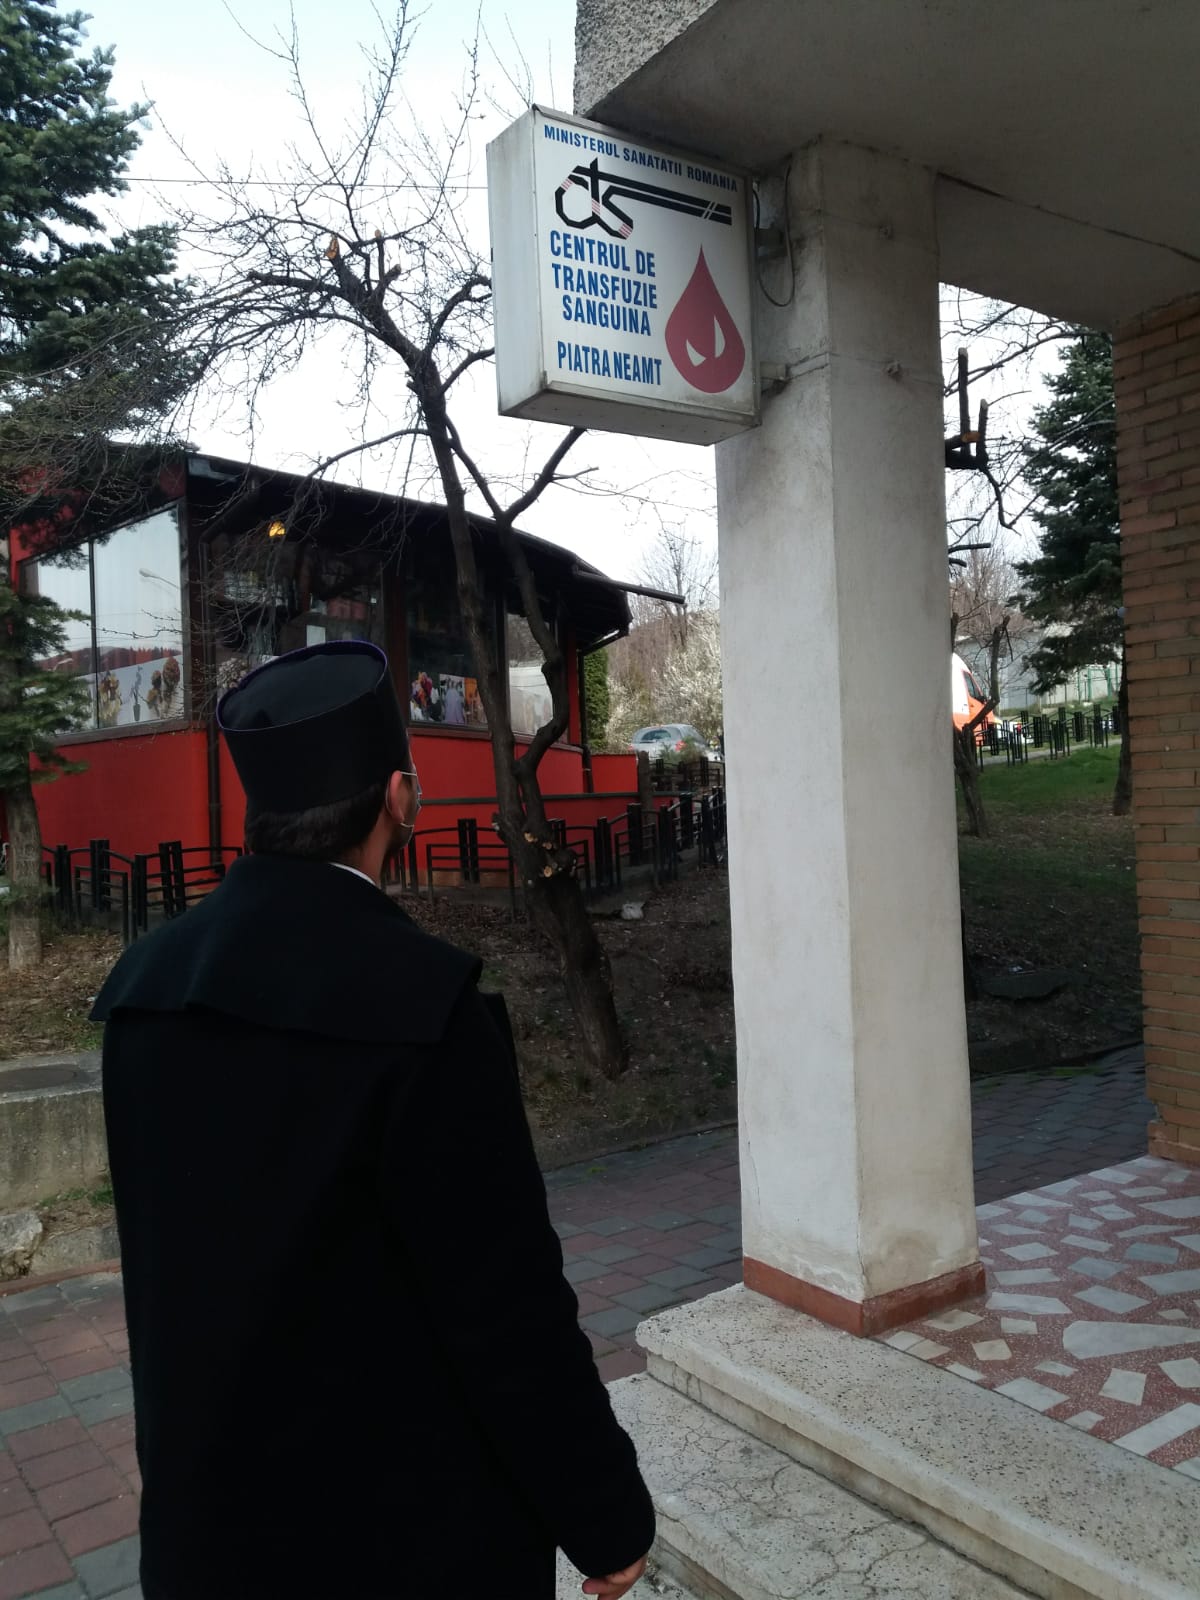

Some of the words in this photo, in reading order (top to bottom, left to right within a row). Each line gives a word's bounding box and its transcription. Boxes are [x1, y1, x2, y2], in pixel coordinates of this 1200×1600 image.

[544, 124, 620, 159] MINISTERUL
[623, 147, 683, 177] SANATATII
[687, 165, 738, 193] ROMANIA
[550, 230, 630, 272] CENTRUL
[635, 249, 656, 278] DE
[551, 263, 657, 309] TRANSFUZIE
[562, 295, 652, 336] SANGUINA
[557, 341, 611, 377] PIATRA
[613, 353, 662, 386] NEAMT
